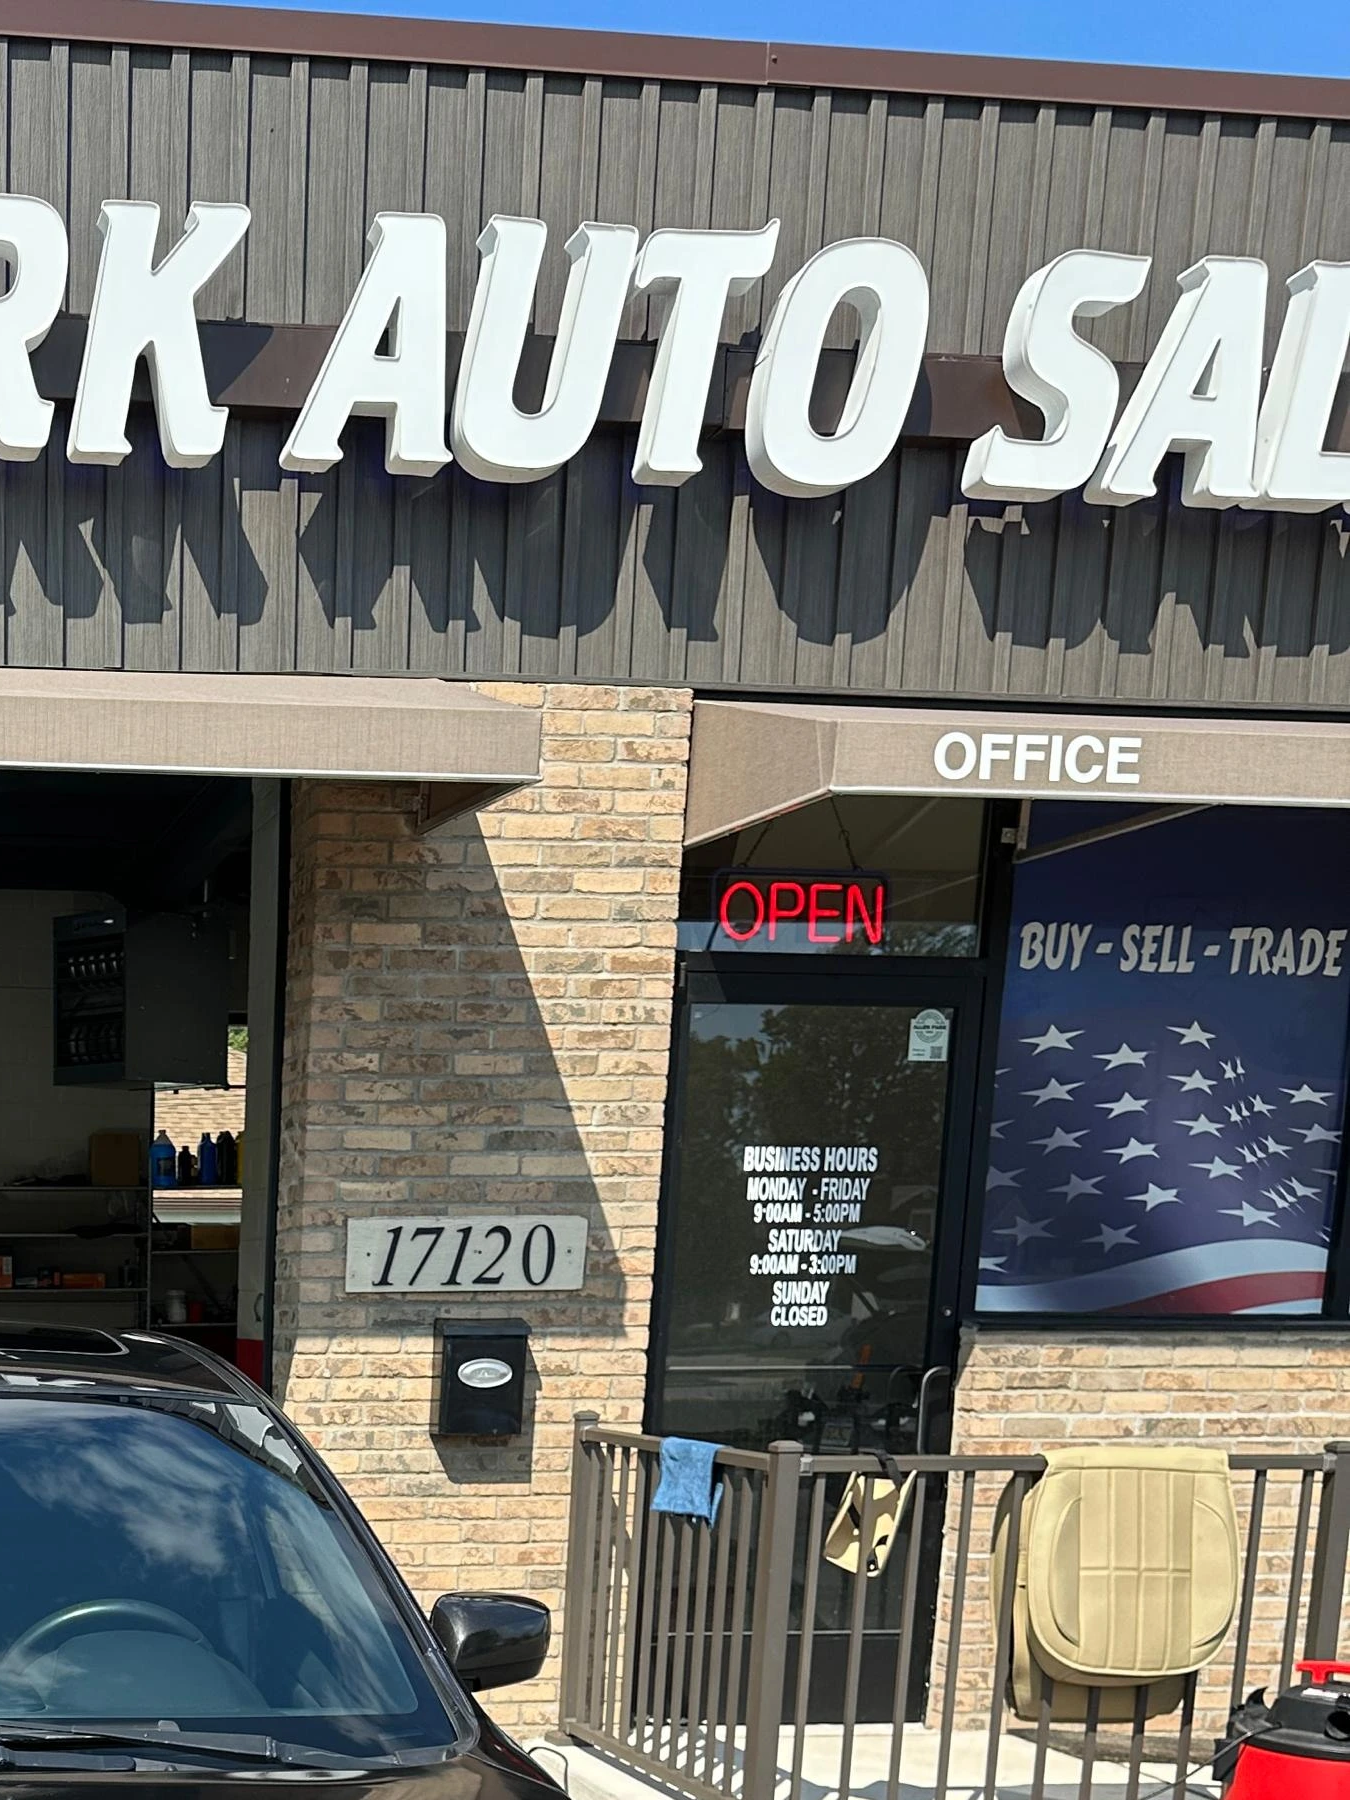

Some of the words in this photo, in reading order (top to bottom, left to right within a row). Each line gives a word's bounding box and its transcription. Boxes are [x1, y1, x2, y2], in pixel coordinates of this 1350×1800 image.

[279, 211, 930, 498] AUTO
[933, 731, 1143, 784] OFFICE
[719, 881, 885, 944] OPEN
[1019, 921, 1093, 971] BUY
[1119, 924, 1195, 974] SELL
[1228, 926, 1349, 977] TRADE
[743, 1146, 821, 1172] BUSINESS
[823, 1146, 879, 1172] HOURS
[746, 1177, 807, 1201] MONDAY
[820, 1177, 870, 1201] FRIDAY
[753, 1202, 803, 1223] 9:00AM
[813, 1203, 861, 1223] 5:00PM
[767, 1228, 842, 1252] SATURDAY
[371, 1224, 556, 1287] 17120
[749, 1254, 799, 1275] 9:00AM
[808, 1254, 857, 1275] 3:00PM
[772, 1280, 830, 1304] SUNDAY
[770, 1305, 828, 1326] CLOSED
